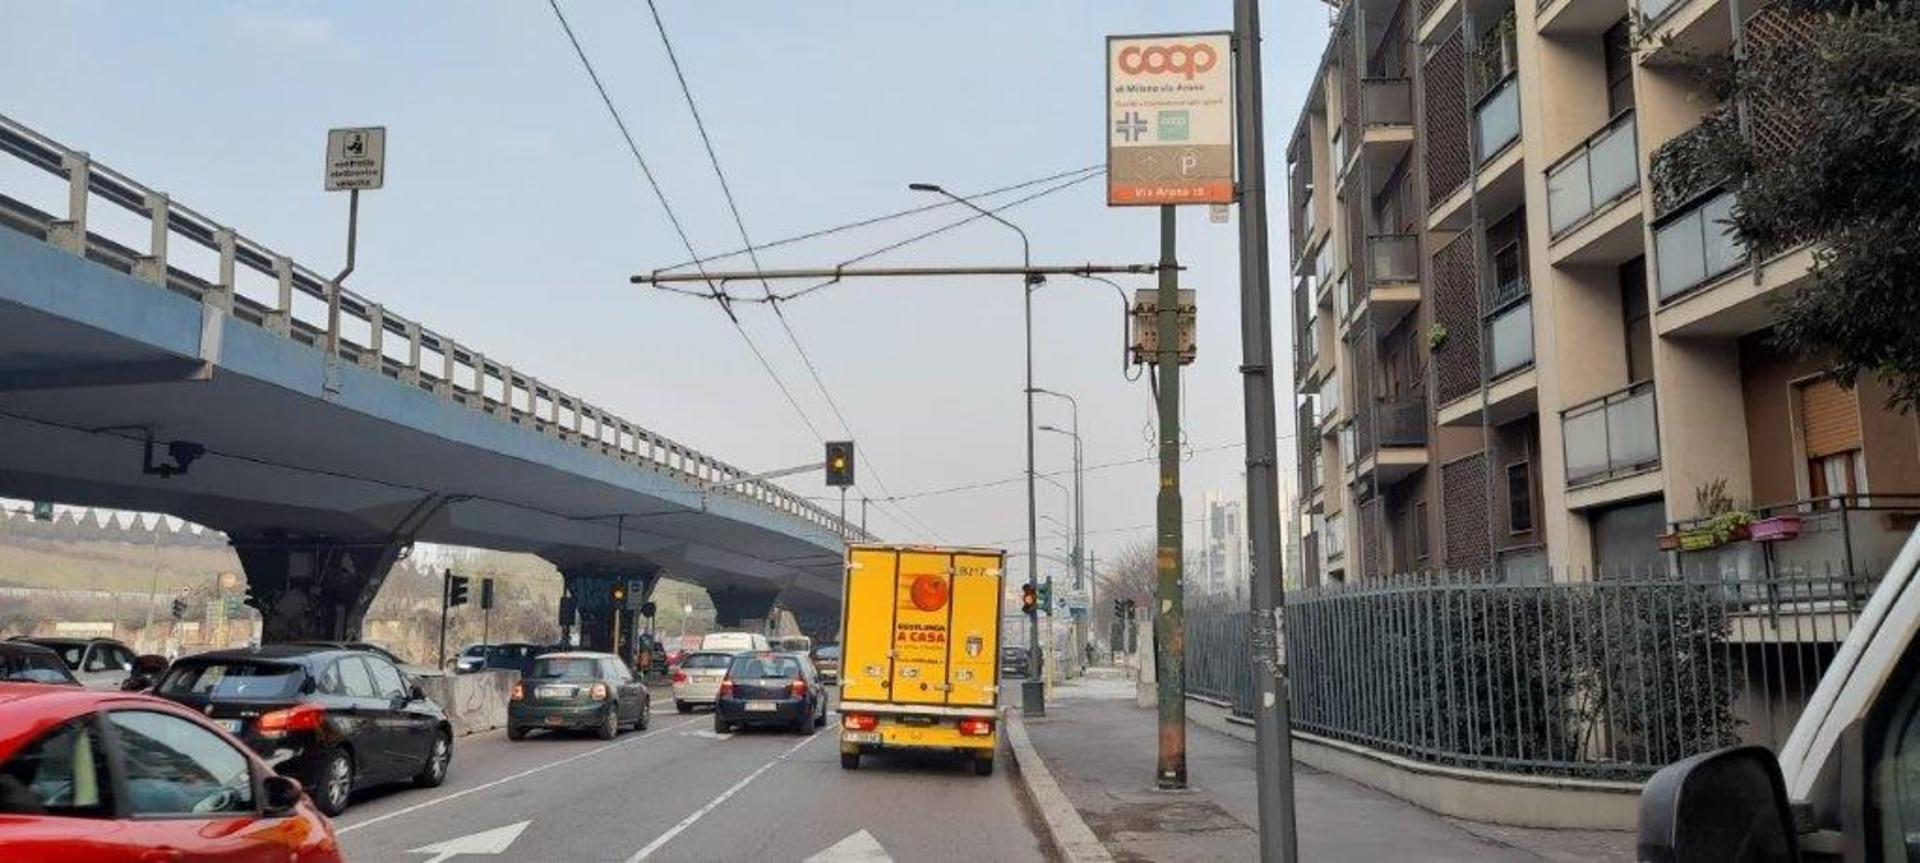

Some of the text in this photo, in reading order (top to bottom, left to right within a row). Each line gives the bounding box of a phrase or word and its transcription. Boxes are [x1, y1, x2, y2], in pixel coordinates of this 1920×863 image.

[1119, 43, 1217, 79] coop
[1127, 84, 1159, 92] Milano
[1135, 187, 1154, 197] Via
[897, 631, 946, 643] A CASA
